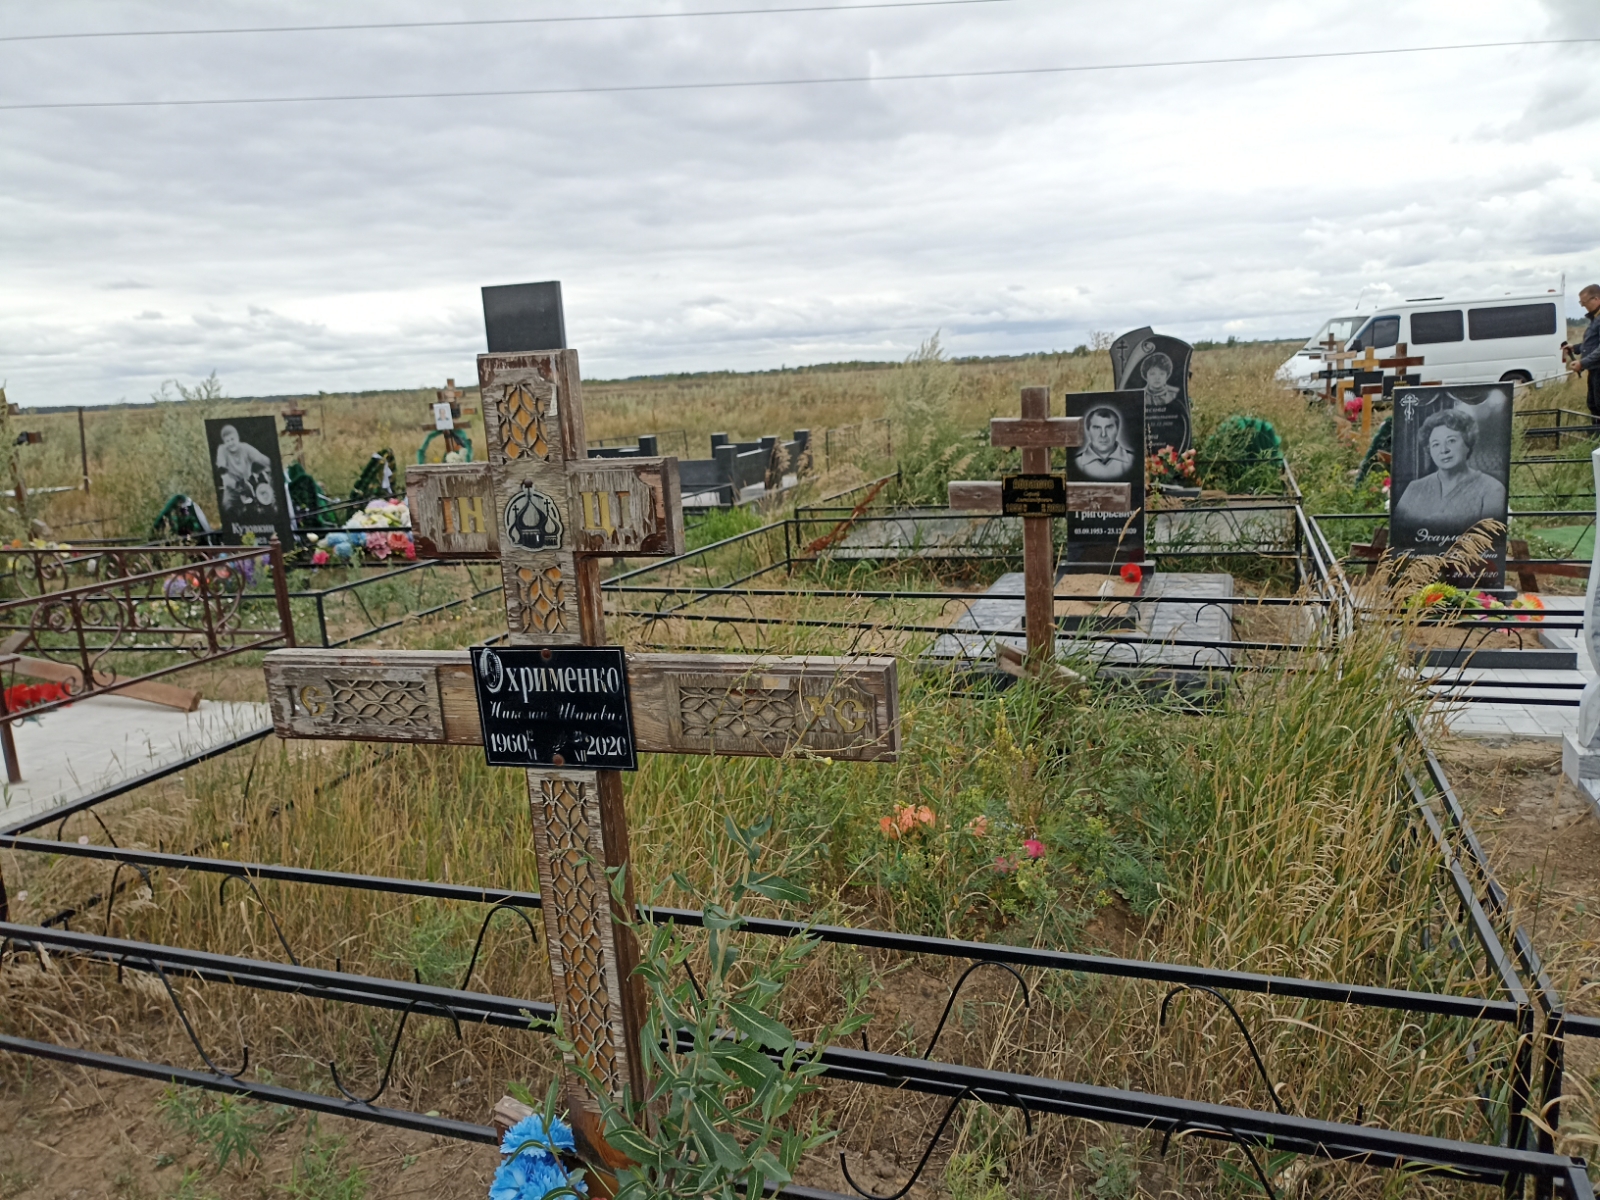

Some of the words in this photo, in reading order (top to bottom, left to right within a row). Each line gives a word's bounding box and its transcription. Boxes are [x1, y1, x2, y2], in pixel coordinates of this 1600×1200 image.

[479, 648, 620, 703] Охрименко
[490, 733, 528, 753] 1960
[585, 735, 627, 756] 2020
